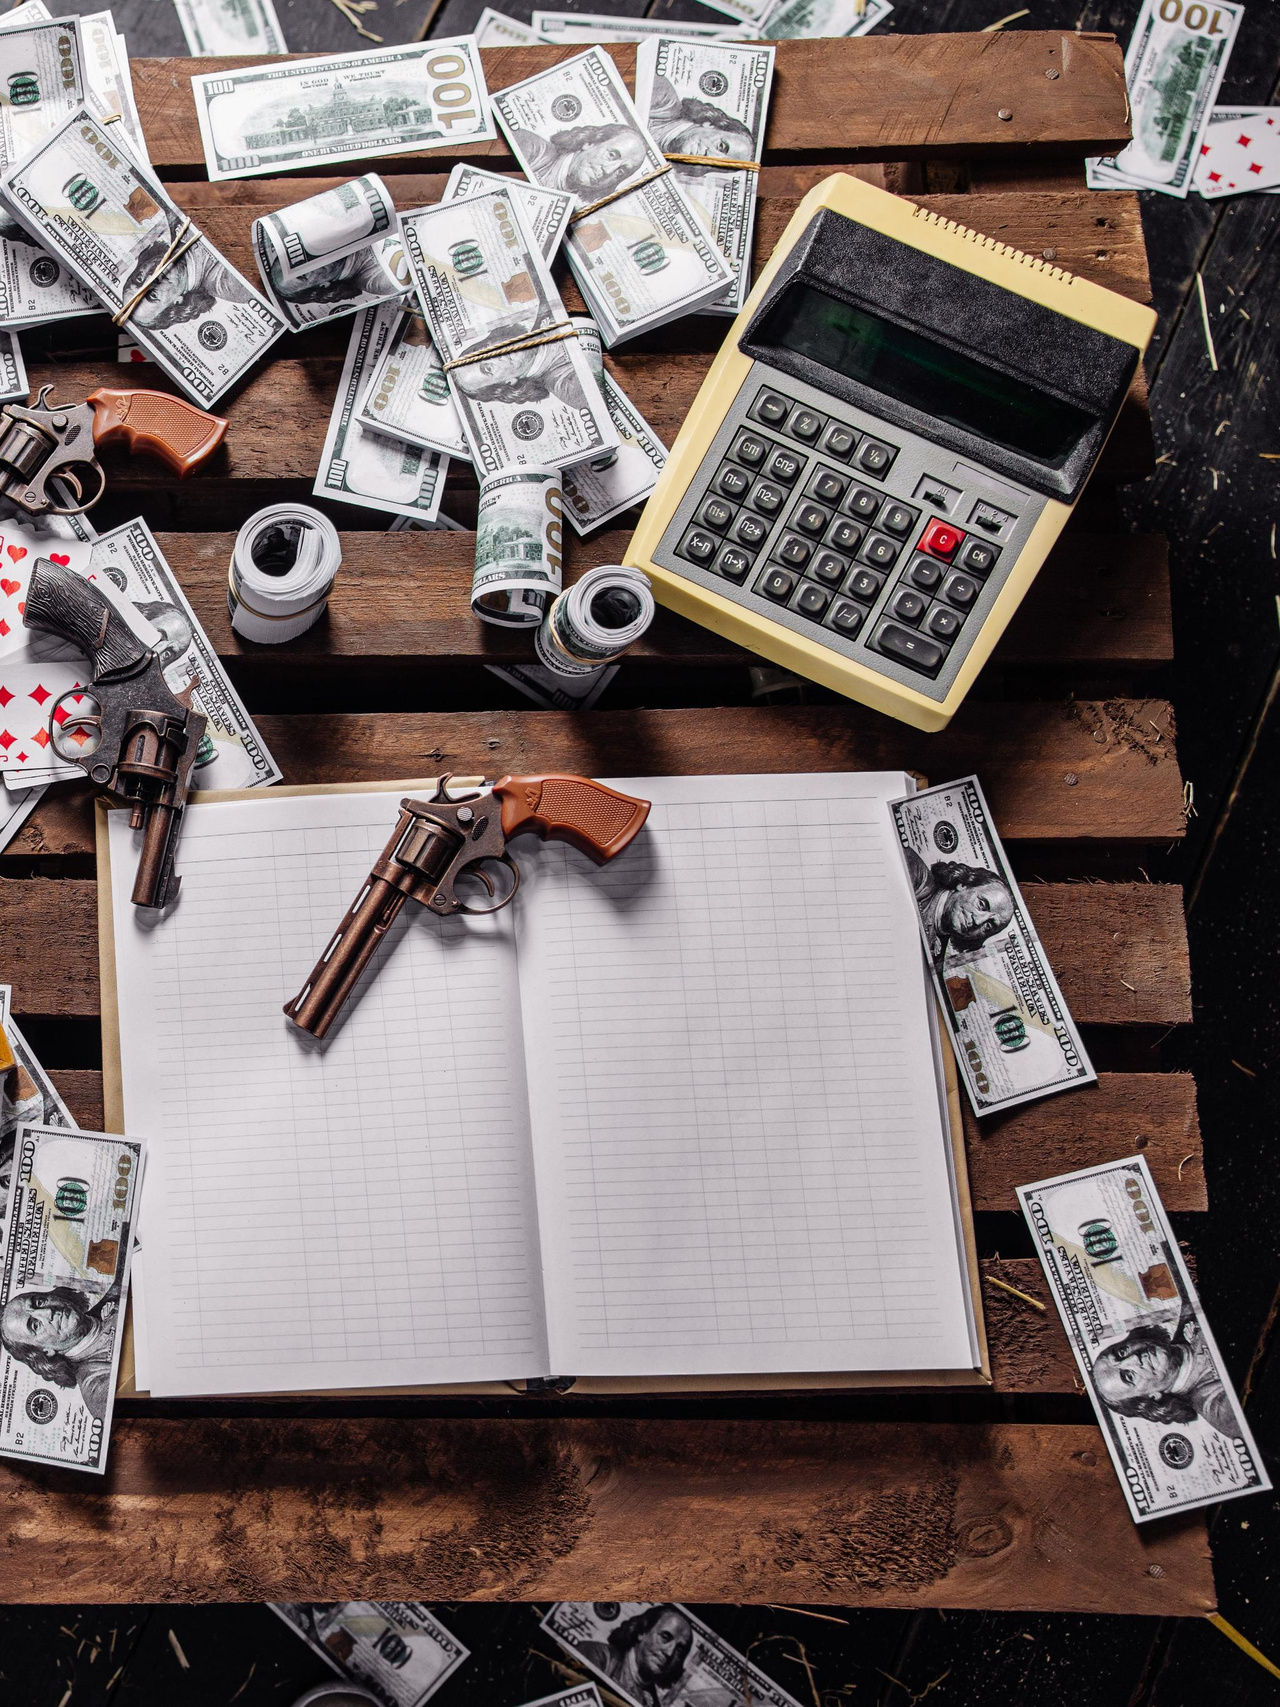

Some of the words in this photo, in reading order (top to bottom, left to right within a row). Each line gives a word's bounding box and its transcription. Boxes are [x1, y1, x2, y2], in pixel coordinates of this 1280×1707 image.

[56, 34, 76, 90] 100
[283, 66, 317, 77] UNITED
[316, 61, 352, 72] STATES
[361, 54, 403, 66] AMERICA
[357, 69, 386, 78] TRUST
[584, 52, 612, 89] 100
[654, 42, 670, 77] 100
[752, 53, 768, 89] 100
[205, 79, 235, 95] 100
[309, 78, 329, 86] GOD
[425, 53, 475, 129] 100
[495, 98, 522, 133] 100
[76, 122, 122, 170] 100
[219, 154, 261, 171] 100
[301, 148, 319, 157] ONE
[318, 142, 361, 155] HUNDRED
[360, 136, 402, 149] DOLLARS
[13, 184, 49, 221] 100
[545, 198, 565, 235] 100
[491, 199, 519, 250] 100
[403, 224, 426, 265] 100
[691, 238, 720, 275] 100
[597, 268, 634, 318] 100
[246, 295, 279, 329] 100
[361, 305, 375, 337] AMERIC
[358, 335, 368, 349] OF
[375, 320, 387, 347] TRUST
[2, 351, 18, 387] 100
[351, 347, 366, 380] STATES
[372, 346, 381, 361] WE
[179, 364, 214, 399] 100
[343, 378, 358, 413] UNITED
[371, 363, 402, 411] 100
[340, 412, 350, 427] THE
[578, 404, 599, 441] 100
[635, 433, 667, 471] 100
[325, 457, 348, 489] 100
[417, 466, 439, 506] 100
[824, 480, 833, 488] 7
[808, 513, 816, 522] 4
[859, 497, 867, 506] 8
[893, 513, 901, 522] 9
[990, 509, 999, 518] 2
[129, 524, 156, 563] 100
[792, 546, 798, 554] 1
[841, 528, 850, 538] 5
[877, 546, 885, 555] 6
[773, 577, 781, 586] 0
[825, 561, 833, 571] 2
[859, 578, 868, 587] 3
[239, 732, 267, 771] 100
[962, 783, 986, 825] 100
[889, 809, 913, 850] 100
[1052, 1023, 1079, 1069] 100
[960, 1038, 992, 1096] 100
[16, 1139, 37, 1182] 100
[109, 1153, 135, 1213] 100
[1027, 1199, 1054, 1246] 100
[1121, 1174, 1157, 1237] 100
[3, 1353, 13, 1375] NOTE
[14, 1430, 25, 1445] B2
[85, 1416, 105, 1463] 100
[1230, 1433, 1258, 1483] 100
[1122, 1464, 1150, 1513] 100
